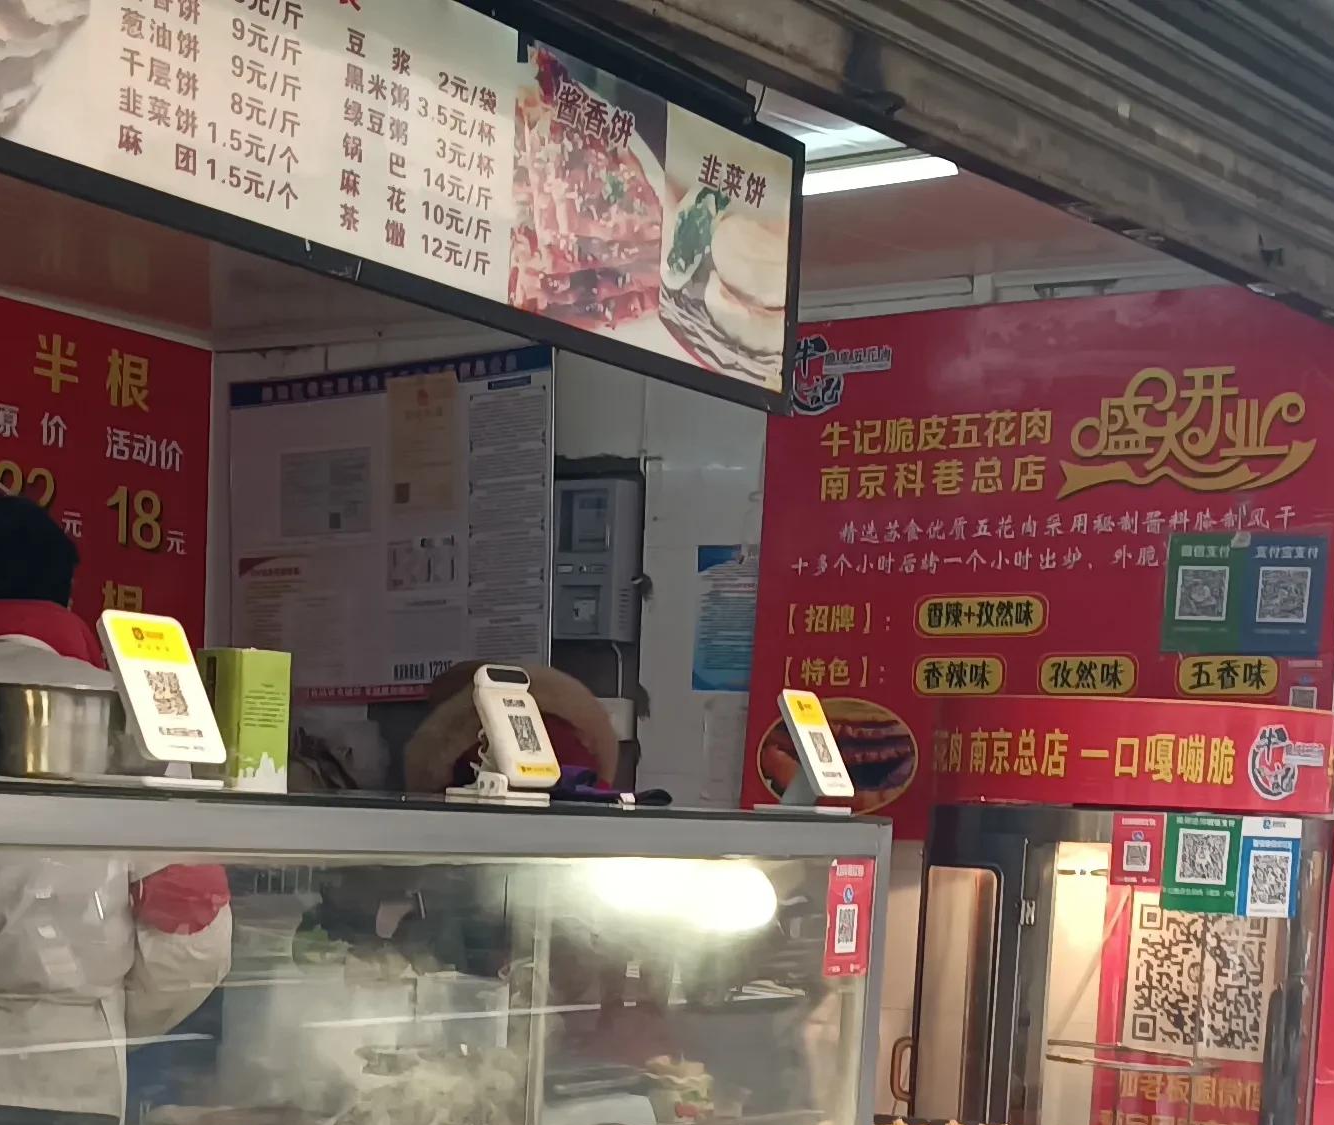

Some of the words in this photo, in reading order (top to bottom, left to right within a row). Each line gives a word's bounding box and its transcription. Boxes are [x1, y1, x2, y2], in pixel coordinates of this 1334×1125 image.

[235, 0, 303, 29] 元/斤
[120, 7, 200, 62] 葱油饼
[231, 55, 301, 101] 9元/斤
[232, 18, 302, 65] 9元/斤
[120, 47, 199, 100] 千层饼
[230, 92, 300, 137] 8元/斤
[344, 63, 410, 112] 黑米粥
[418, 97, 496, 146] 3.5元/杯
[438, 71, 497, 115] 2元/袋
[556, 79, 634, 148] 酱香饼
[119, 87, 198, 138] 韭菜饼
[208, 121, 299, 173] 1.5元/个
[343, 97, 408, 146] 绿豆粥
[436, 138, 495, 179] 3元/杯
[207, 158, 298, 209] 1.5元/个
[423, 168, 493, 210] 14元/斤
[698, 153, 767, 209] 韭菜饼
[422, 200, 492, 244] 10元/斤
[421, 234, 491, 276] 12元/斤
[106, 426, 183, 472] 活动价
[820, 408, 1052, 457] 牛记脆皮五花肉
[820, 454, 1048, 501] 南京科巷总店
[107, 485, 161, 550] 18
[927, 600, 1033, 628] 香辣+孜然味
[924, 661, 992, 689] 香辣味
[1049, 660, 1124, 689] 孜然味
[1190, 659, 1268, 690] 五香味
[970, 727, 1068, 777] 南京总店
[1081, 734, 1235, 785] 一口嘎嘣脆
